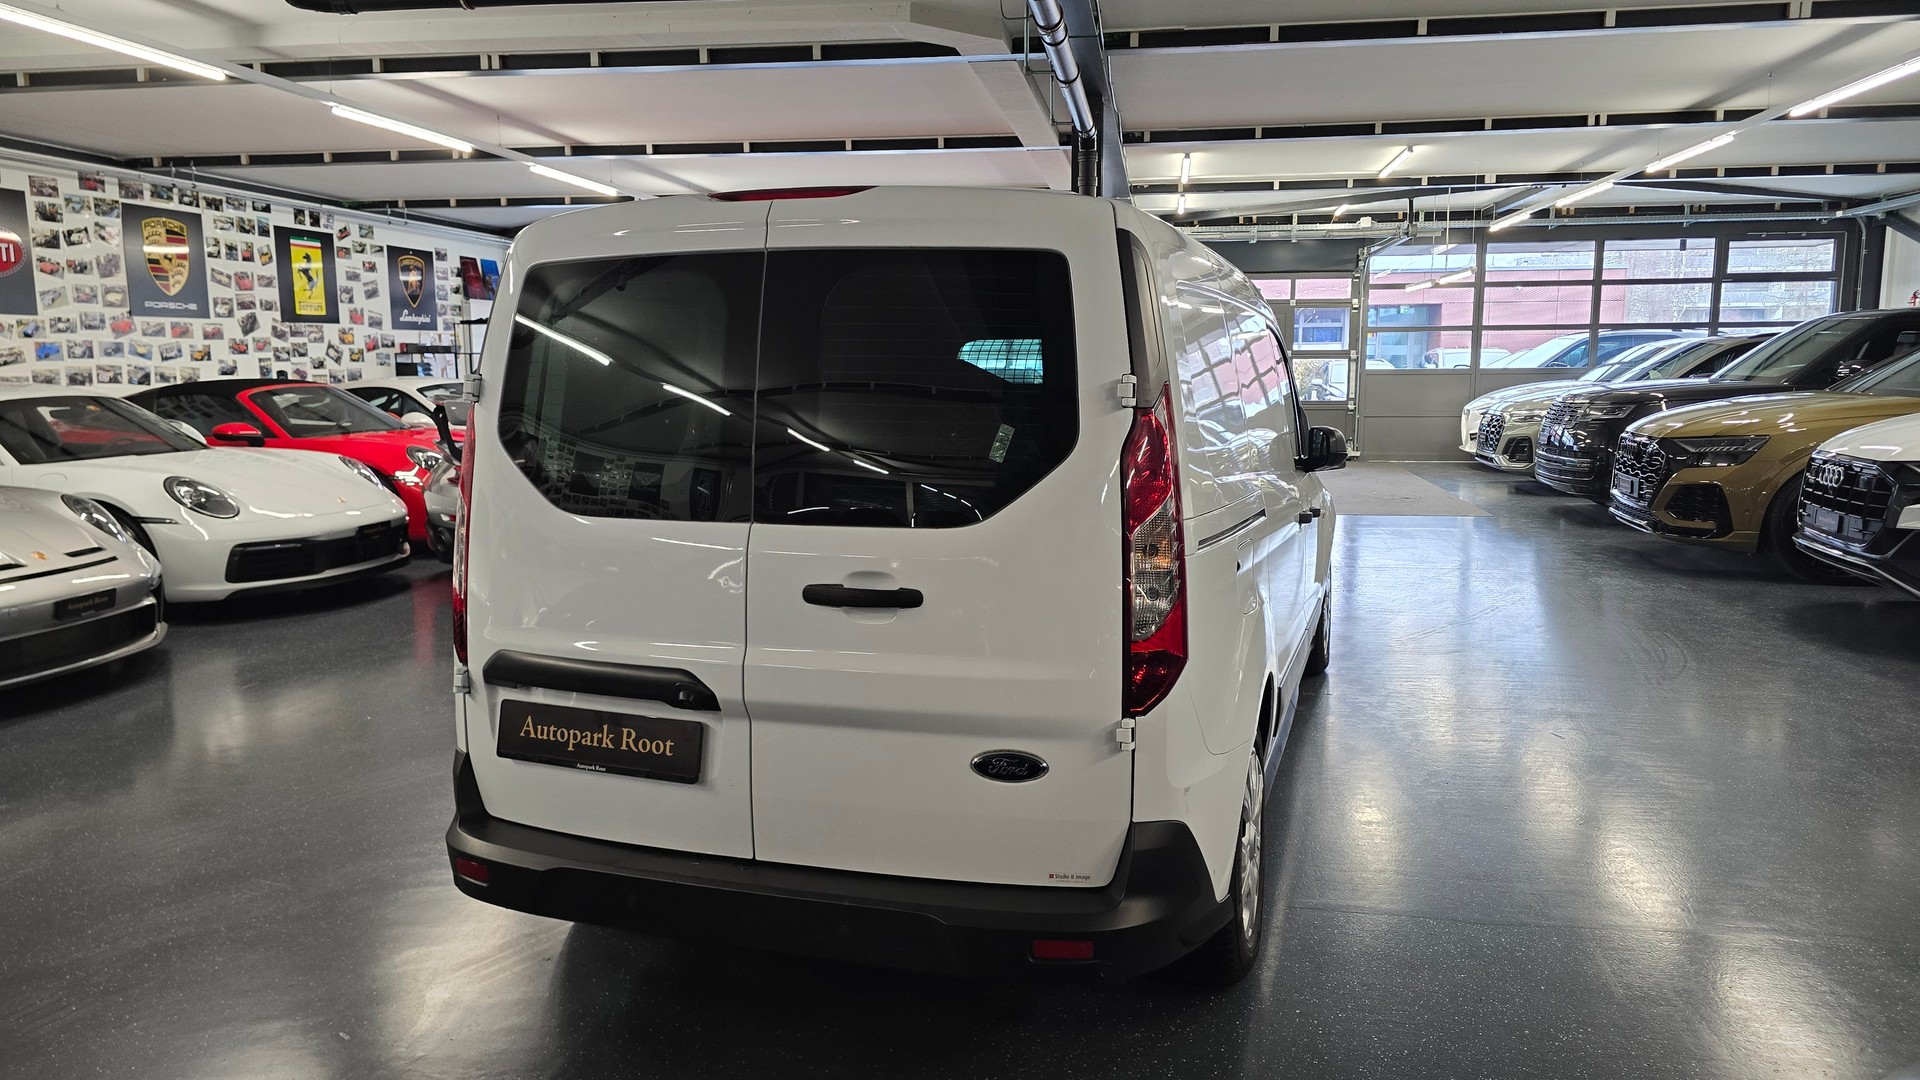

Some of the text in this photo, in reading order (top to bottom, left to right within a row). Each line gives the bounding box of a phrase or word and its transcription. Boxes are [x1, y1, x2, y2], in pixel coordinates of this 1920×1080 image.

[144, 300, 198, 311] PORSCHE
[399, 308, 431, 325] Lamborghini
[519, 715, 675, 757] Autopark Root
[988, 757, 1028, 776] Ford
